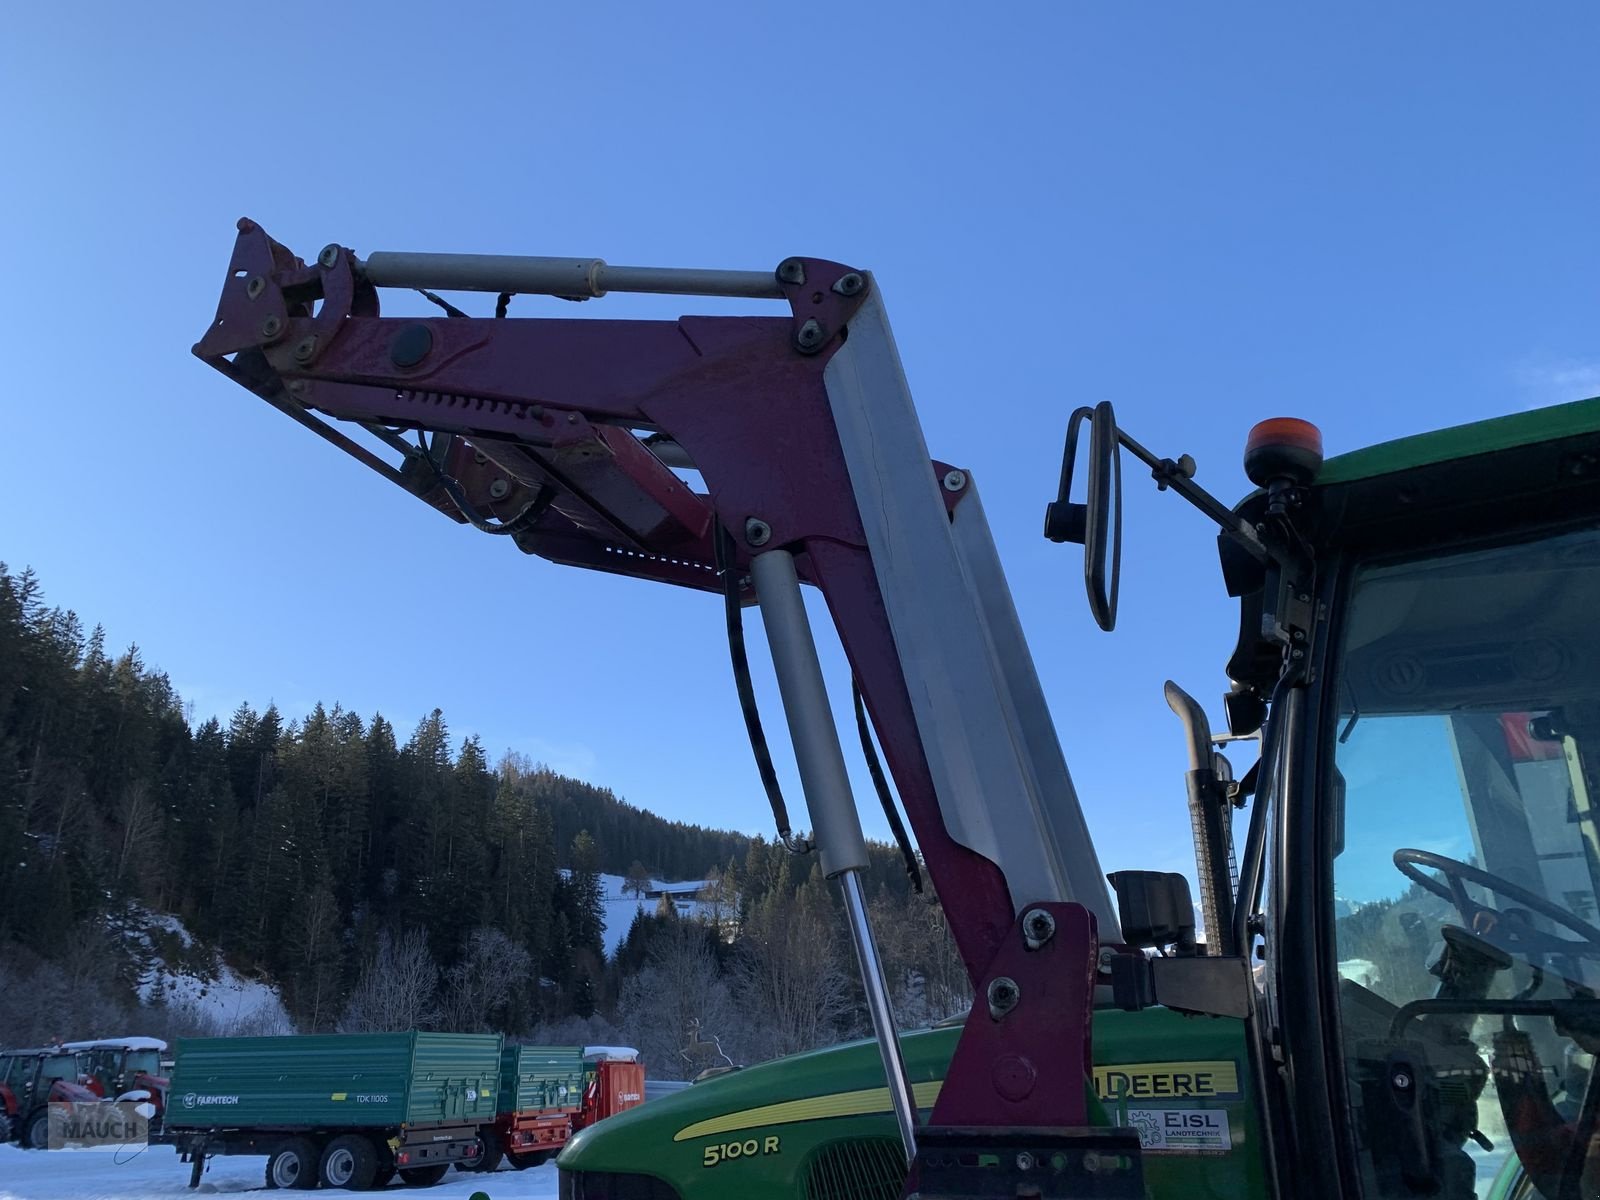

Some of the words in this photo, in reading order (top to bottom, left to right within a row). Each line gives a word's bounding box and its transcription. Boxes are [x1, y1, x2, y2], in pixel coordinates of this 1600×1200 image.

[1106, 1072, 1214, 1096] DEERE
[197, 1096, 239, 1105] FARMTECH
[1164, 1112, 1219, 1128] EISL
[703, 1139, 759, 1166] 5100
[764, 1136, 779, 1154] R
